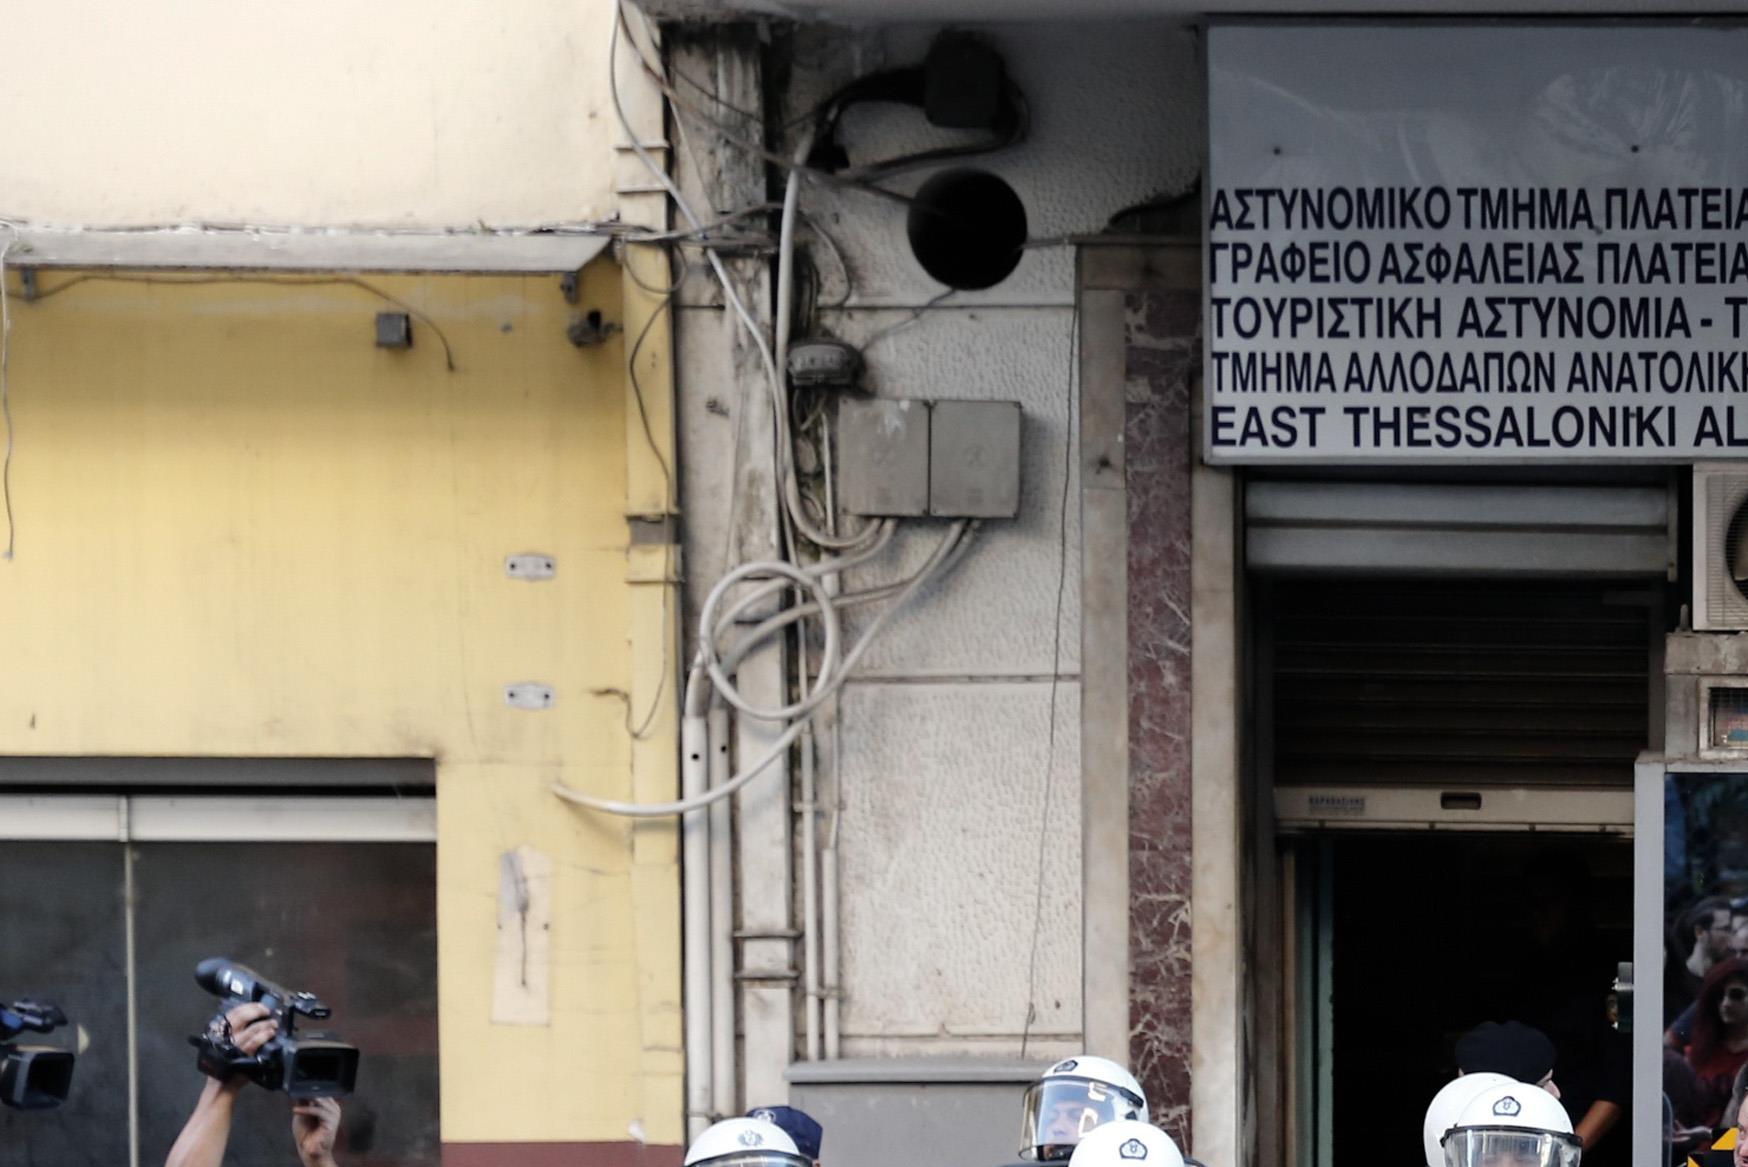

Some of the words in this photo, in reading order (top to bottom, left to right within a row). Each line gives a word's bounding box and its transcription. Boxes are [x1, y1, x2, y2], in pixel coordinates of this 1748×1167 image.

[1210, 186, 1450, 231] ΑΣΤΥΝΟΜΙΚΟ
[1457, 187, 1594, 230] ΤΜΗΜΑ
[1210, 241, 1371, 284] ΓΡΑΦΕΙΟ
[1378, 241, 1584, 284] ΑΣΦΑΛΕΙΑΣ
[1211, 297, 1442, 339] ΤΟΥΡΙΣΤΙΚΗ
[1457, 297, 1692, 339] ΑΣΤΥΝΟΜΙΑ
[1212, 351, 1337, 394] ΤΜΗΜΑ
[1344, 351, 1555, 394] ΑΛΛΟΔΑΠΩΝ
[1212, 406, 1326, 448] EAST
[1343, 405, 1676, 448] THESSALONIKI
